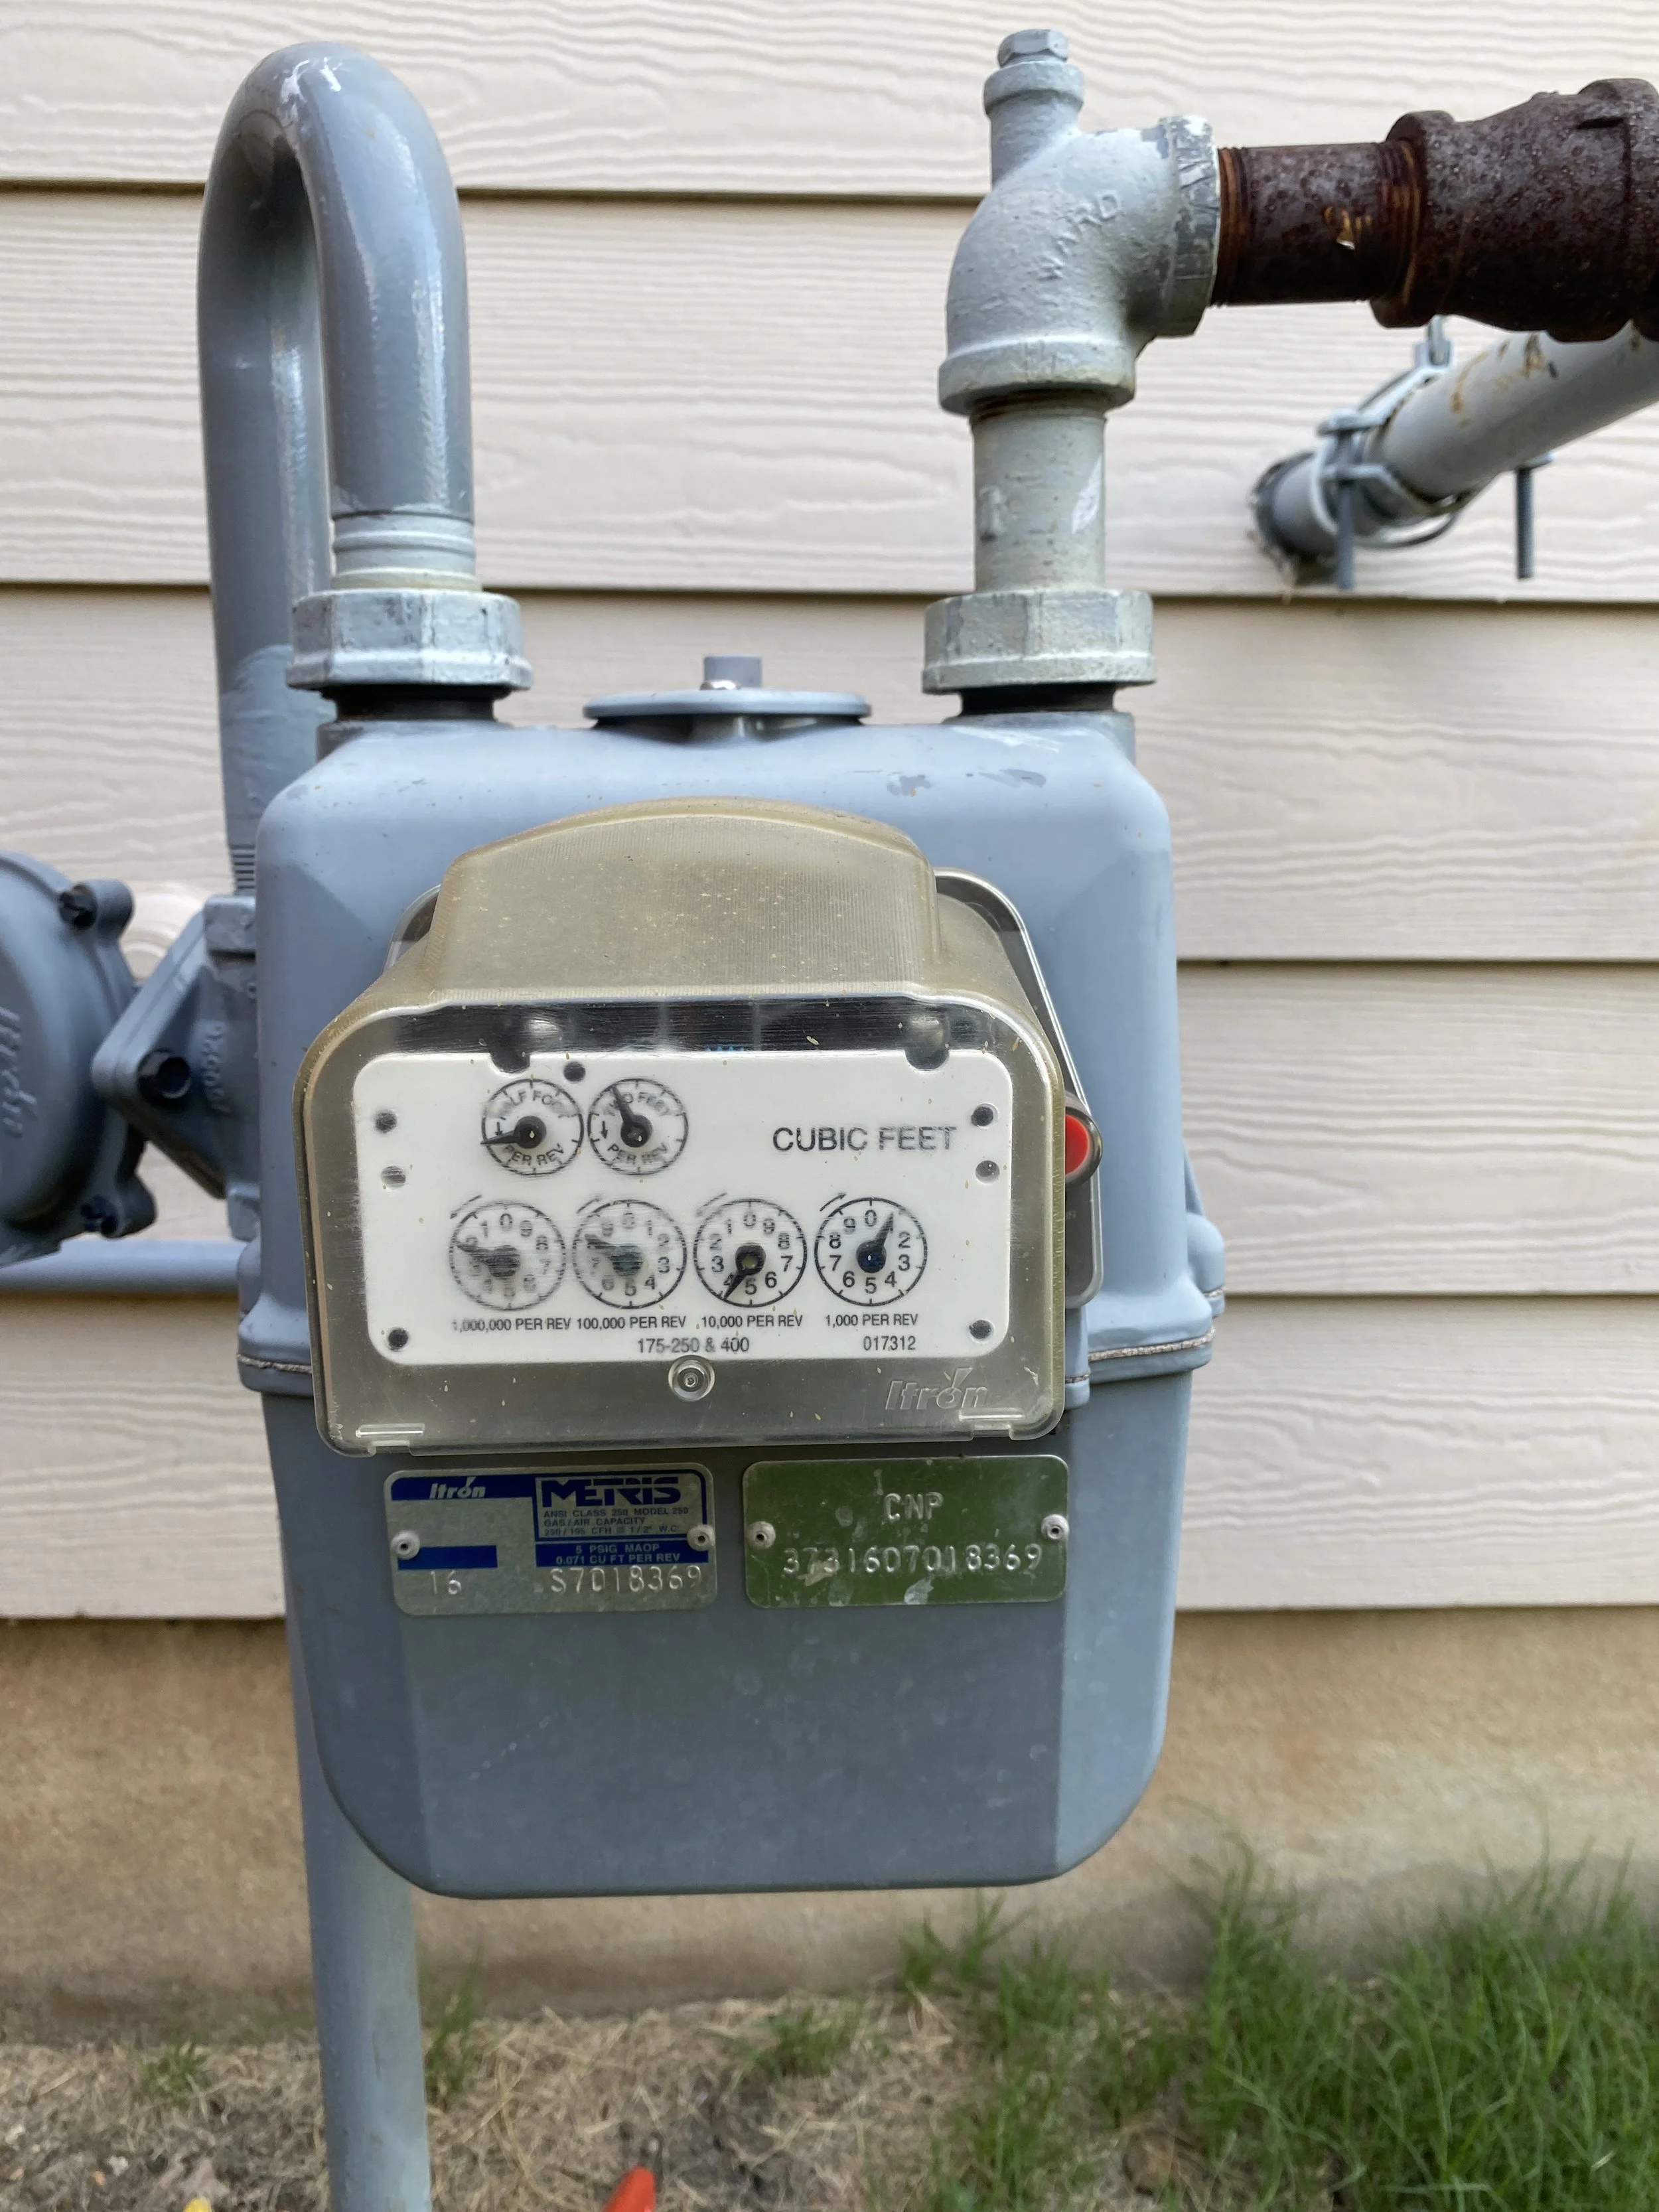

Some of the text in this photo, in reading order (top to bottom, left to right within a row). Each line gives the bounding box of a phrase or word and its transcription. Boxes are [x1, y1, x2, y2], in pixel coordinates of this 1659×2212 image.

[773, 1126, 958, 1151] CUBIC FEET
[503, 1143, 564, 1165] PER REV
[499, 1213, 513, 1231] 0
[743, 1211, 757, 1228] 0
[843, 1217, 856, 1235] 9
[864, 1209, 877, 1227] 0
[778, 1232, 790, 1250] 8
[829, 1232, 841, 1249] 8
[898, 1231, 911, 1249] 2
[658, 1256, 670, 1274] 3
[711, 1255, 725, 1273] 3
[780, 1255, 794, 1272] 7
[829, 1254, 842, 1272] 7
[898, 1254, 911, 1272] 3
[644, 1274, 656, 1290] 4
[745, 1277, 758, 1295] 5
[764, 1271, 778, 1289] 6
[842, 1270, 855, 1288] 6
[864, 1276, 877, 1294] 5
[885, 1270, 897, 1288] 4
[515, 1318, 543, 1331] PER
[547, 1317, 571, 1330] REV
[577, 1316, 687, 1331] 100,000 PER REV
[701, 1315, 803, 1329] 10,000 PER REV
[825, 1314, 918, 1328] 1,000 PER REV
[638, 1337, 750, 1353] 175-250 & 400
[863, 1335, 916, 1351] 017312
[885, 1367, 989, 1410] Itron
[429, 1477, 486, 1499] Itron
[541, 1477, 681, 1507] METRIS
[543, 1509, 567, 1518] ANSI
[573, 1509, 607, 1517] CLASS
[883, 1492, 944, 1520] CNP
[596, 1517, 645, 1526] CAPACITY
[576, 1543, 660, 1554] 5 PSIG MAOP
[556, 1553, 680, 1565] 0.071 CU FT PER REV
[430, 1569, 462, 1597] 16
